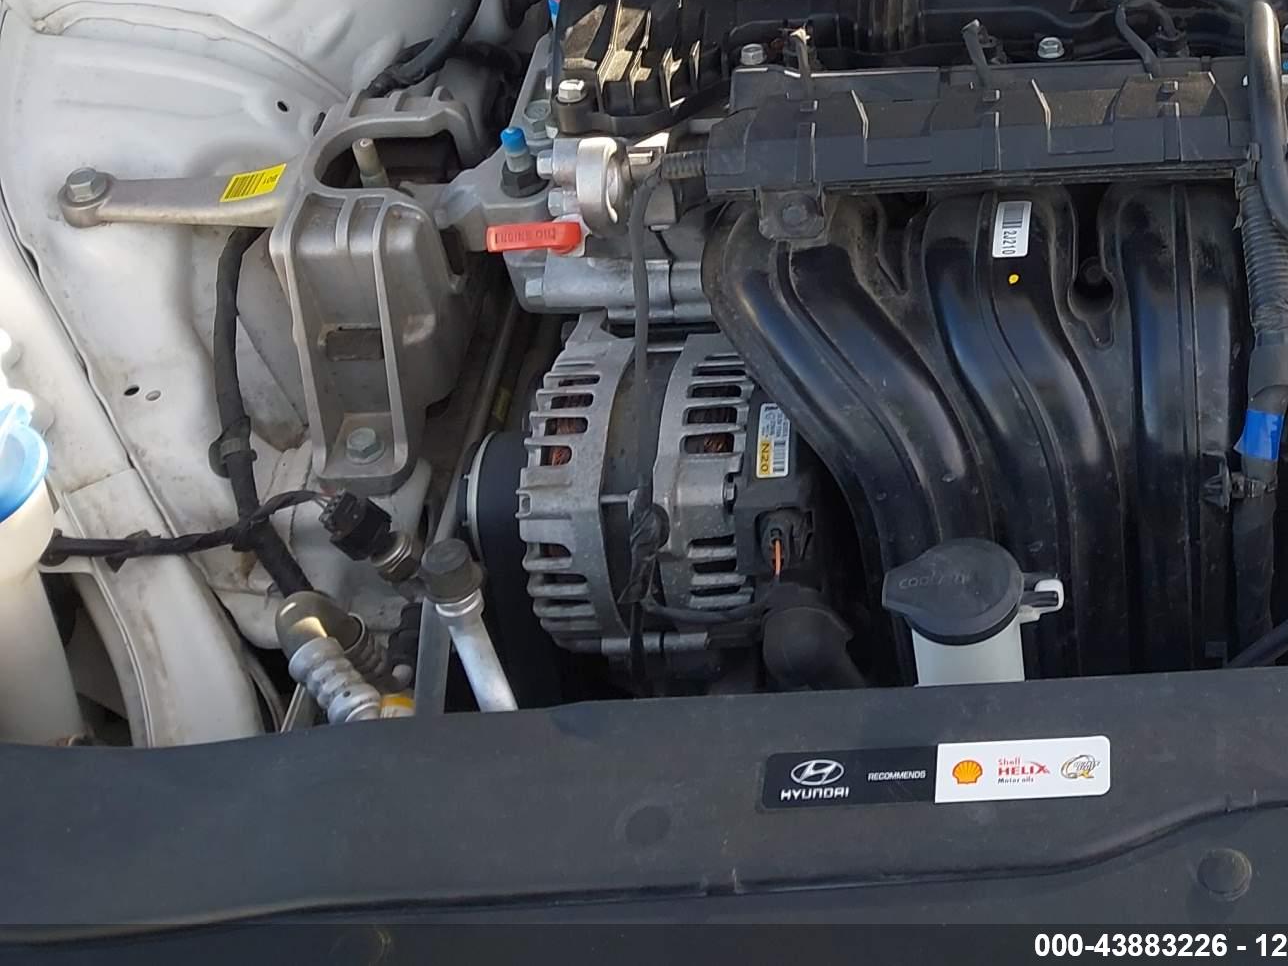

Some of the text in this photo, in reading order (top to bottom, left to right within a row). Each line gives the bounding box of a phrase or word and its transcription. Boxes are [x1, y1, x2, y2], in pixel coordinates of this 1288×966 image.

[1001, 229, 1018, 255] 2J210
[760, 442, 770, 472] N20
[868, 770, 927, 781] RECOMMENDS
[998, 761, 1050, 776] HELIX
[780, 786, 850, 801] HYUNDAI
